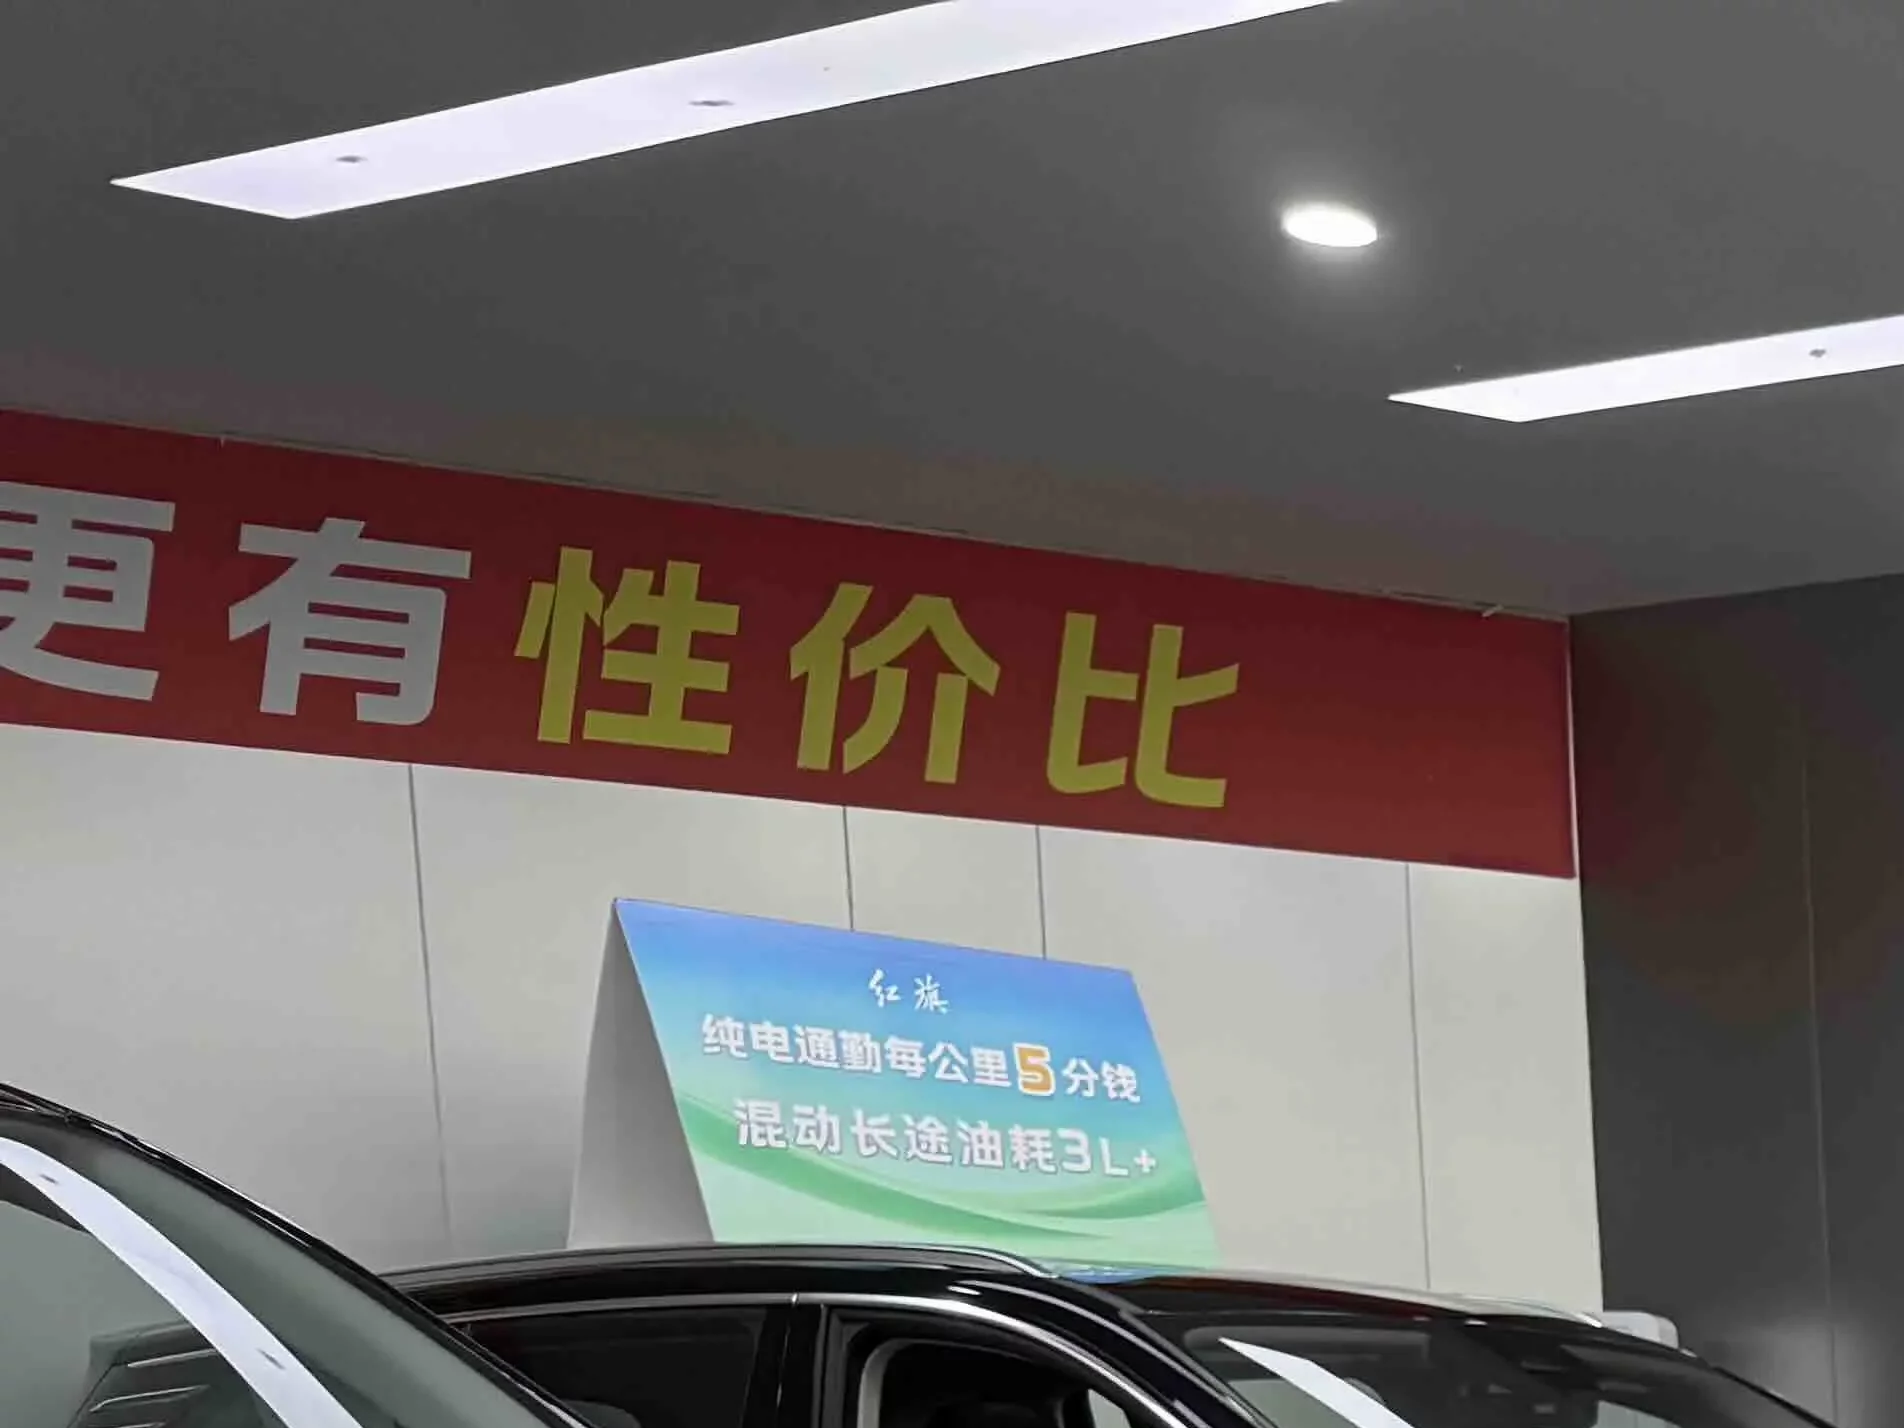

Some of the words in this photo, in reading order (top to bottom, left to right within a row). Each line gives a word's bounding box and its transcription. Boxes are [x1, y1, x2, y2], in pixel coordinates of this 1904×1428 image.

[0, 480, 1241, 811] 更有性价比
[868, 969, 950, 1015] 红旗
[702, 1014, 1142, 1103] 纯电通勤每公里5分钱
[734, 1098, 1157, 1178] 混动长途油耗3L+
